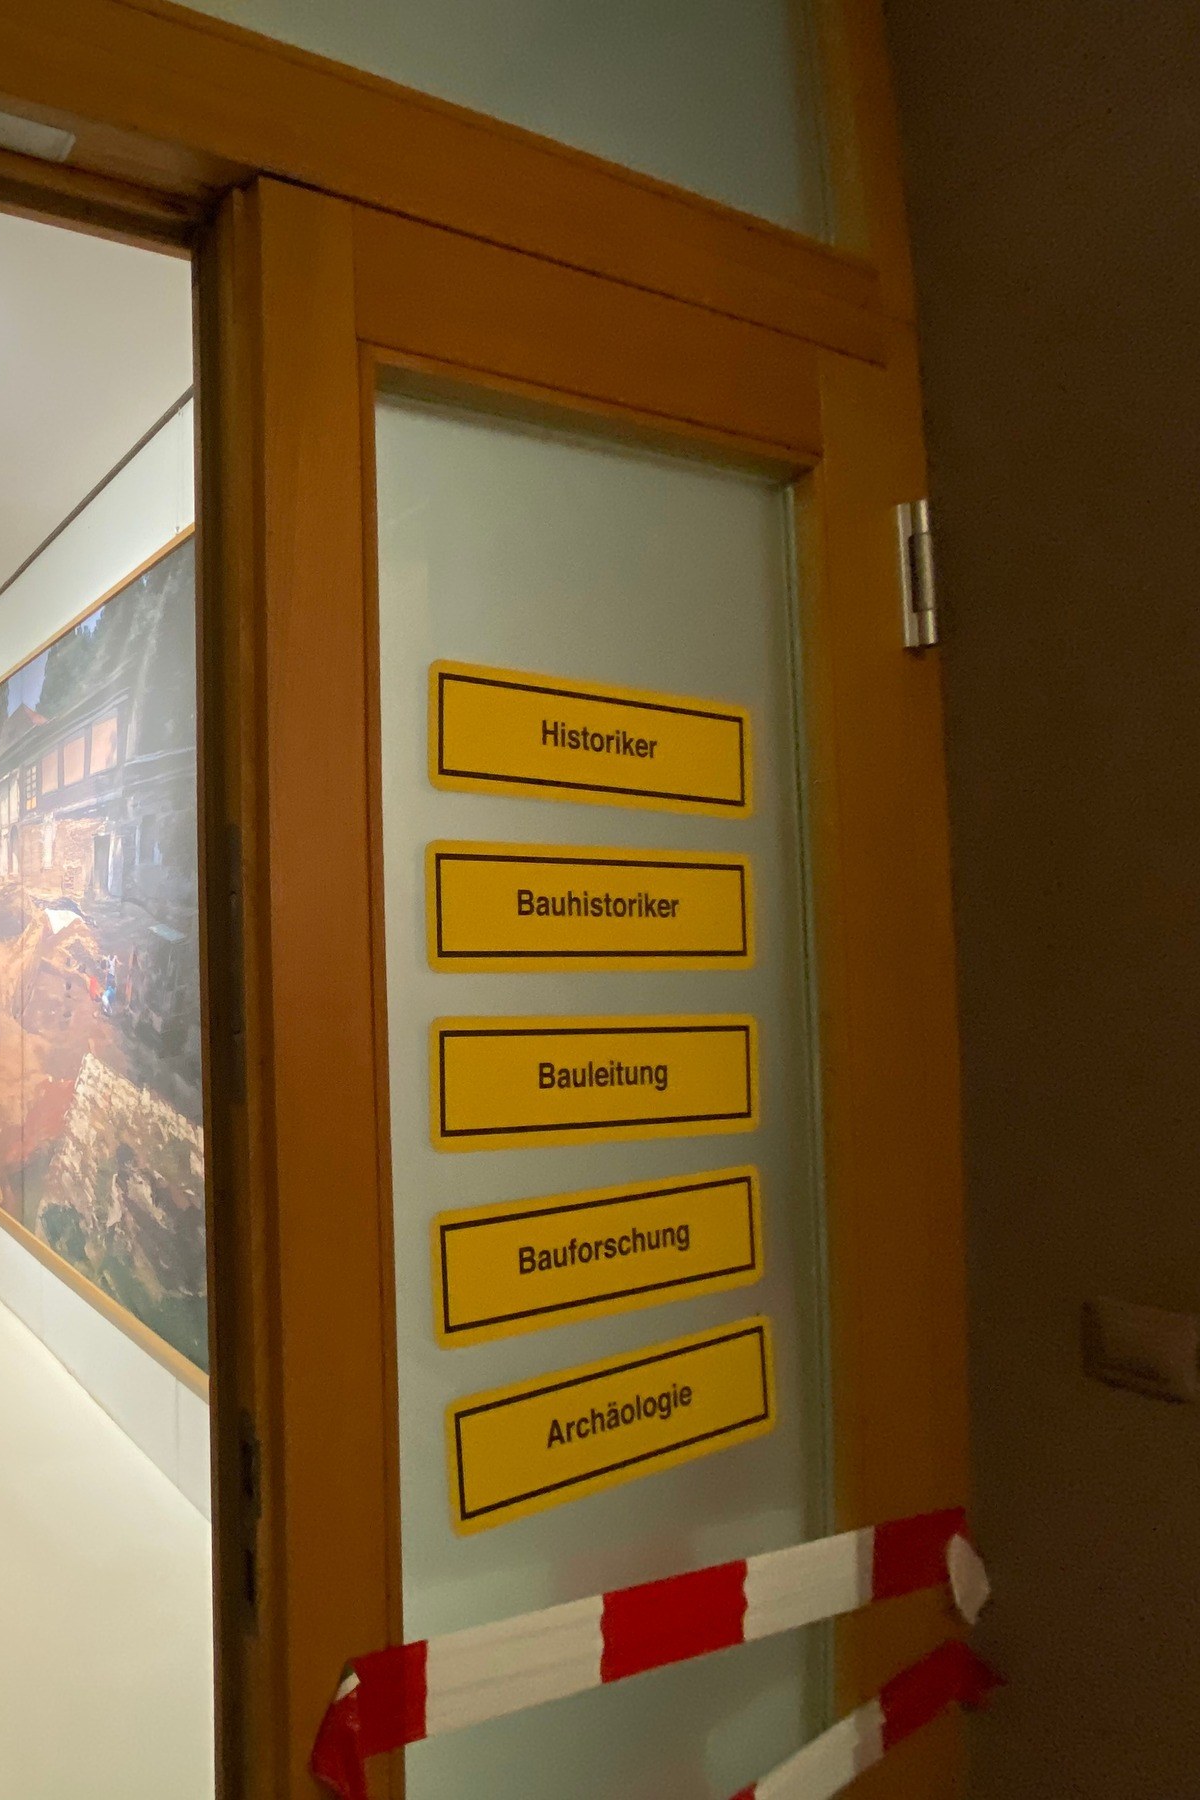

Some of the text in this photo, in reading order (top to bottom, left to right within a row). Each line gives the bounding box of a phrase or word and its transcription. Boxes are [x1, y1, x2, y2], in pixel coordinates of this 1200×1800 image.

[541, 719, 658, 759] Historiker
[516, 888, 680, 919] Bauhistoriker
[538, 1060, 669, 1092] Bauleitung
[518, 1223, 690, 1275] Bauforschung
[547, 1382, 693, 1449] Archäologie
